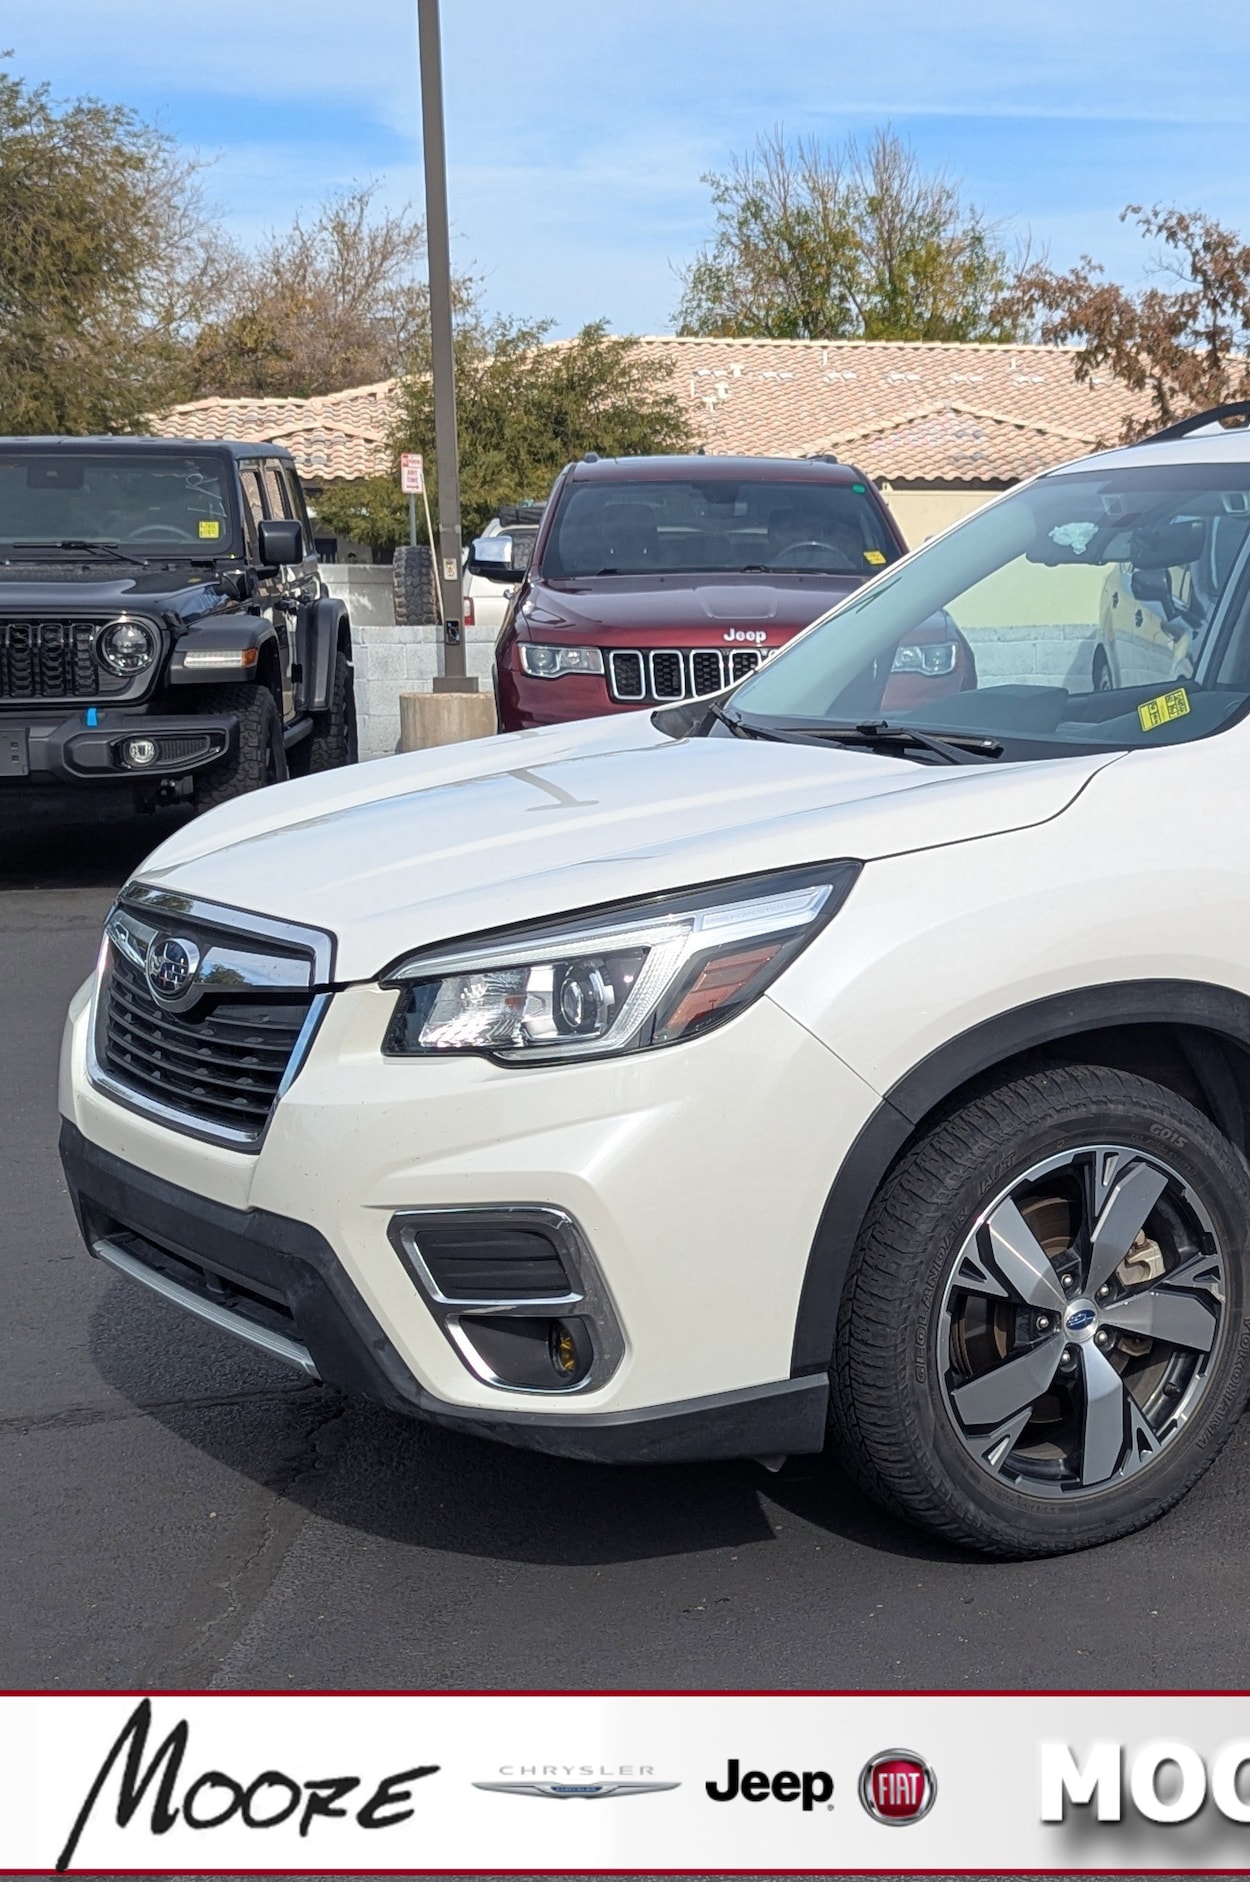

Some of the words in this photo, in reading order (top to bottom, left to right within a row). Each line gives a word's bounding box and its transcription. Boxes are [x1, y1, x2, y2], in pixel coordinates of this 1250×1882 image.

[723, 627, 767, 644] Jeep
[1150, 1123, 1188, 1148] G015
[915, 1207, 969, 1384] GEOLANDAR
